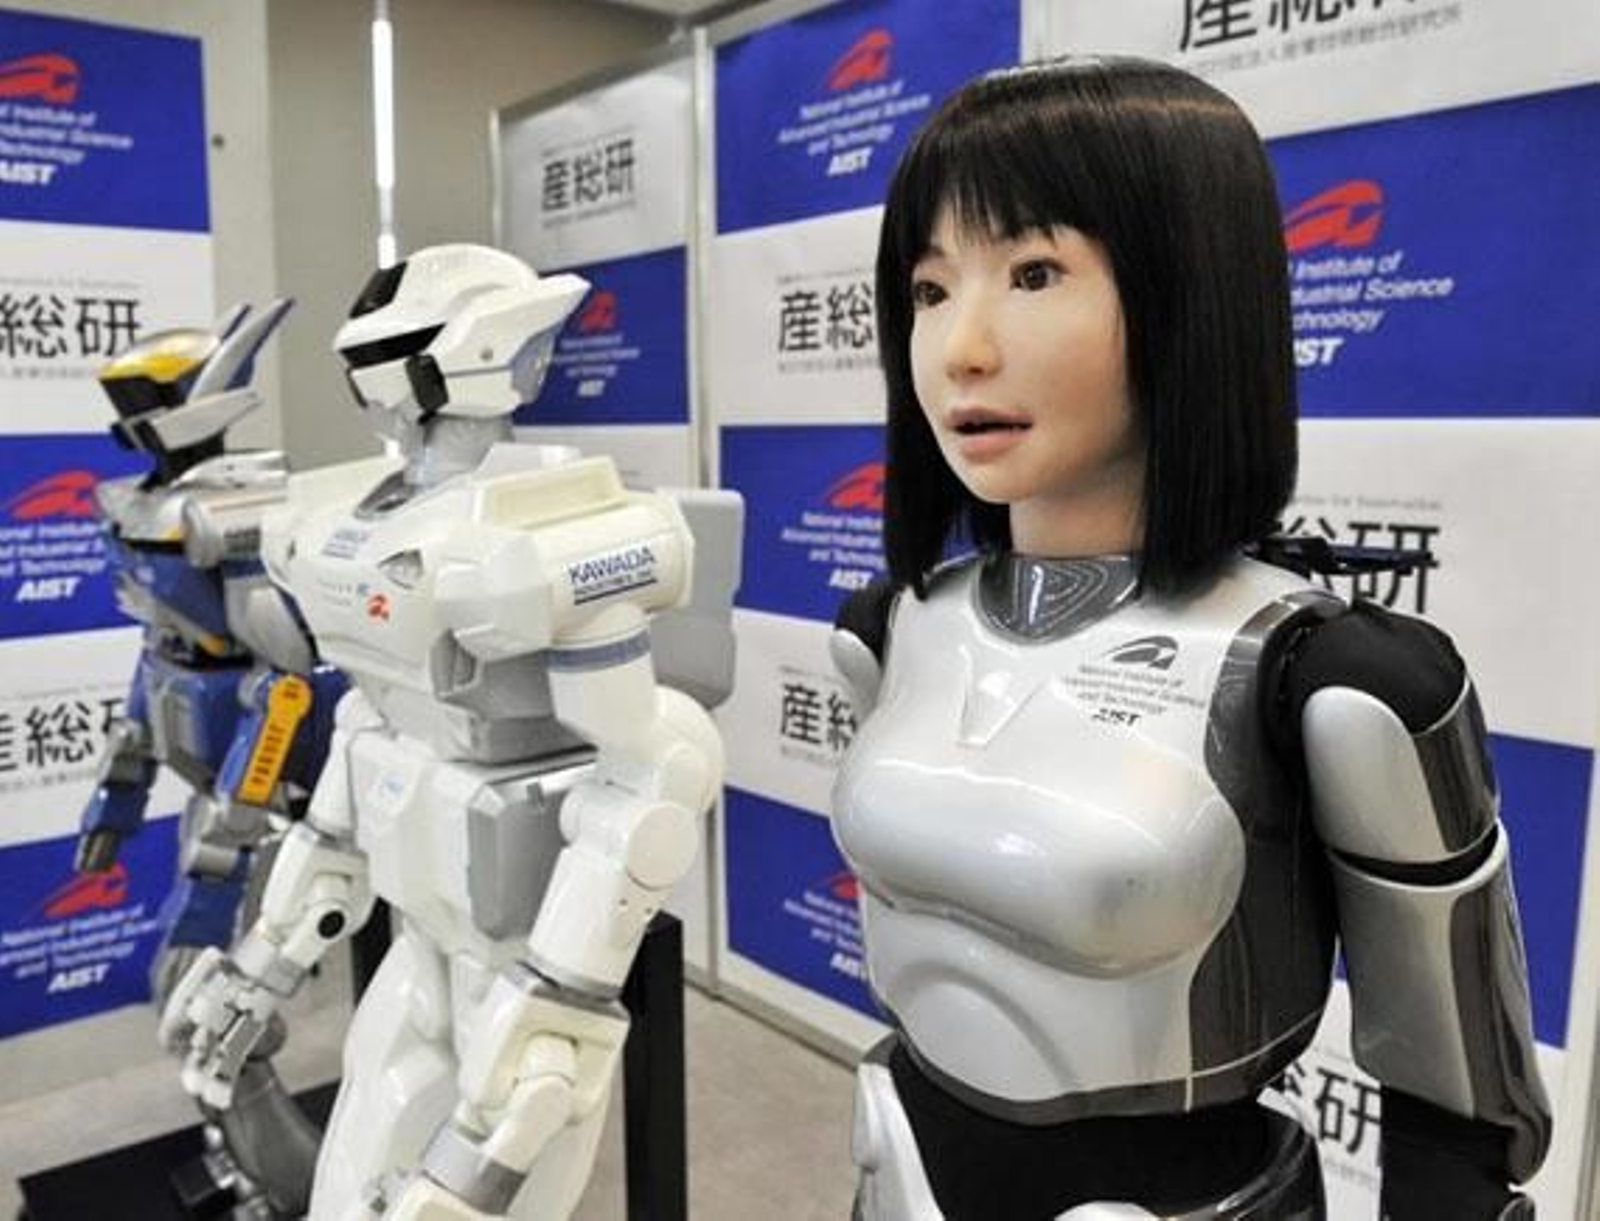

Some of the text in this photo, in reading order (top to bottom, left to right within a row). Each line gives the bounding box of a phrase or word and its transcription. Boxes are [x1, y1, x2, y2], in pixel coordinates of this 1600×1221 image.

[826, 146, 874, 179] AIST
[1376, 249, 1405, 275] of
[1364, 275, 1455, 301] Science
[568, 546, 655, 584] KAWADA
[15, 576, 83, 603] AIST
[47, 962, 112, 995] AIST
